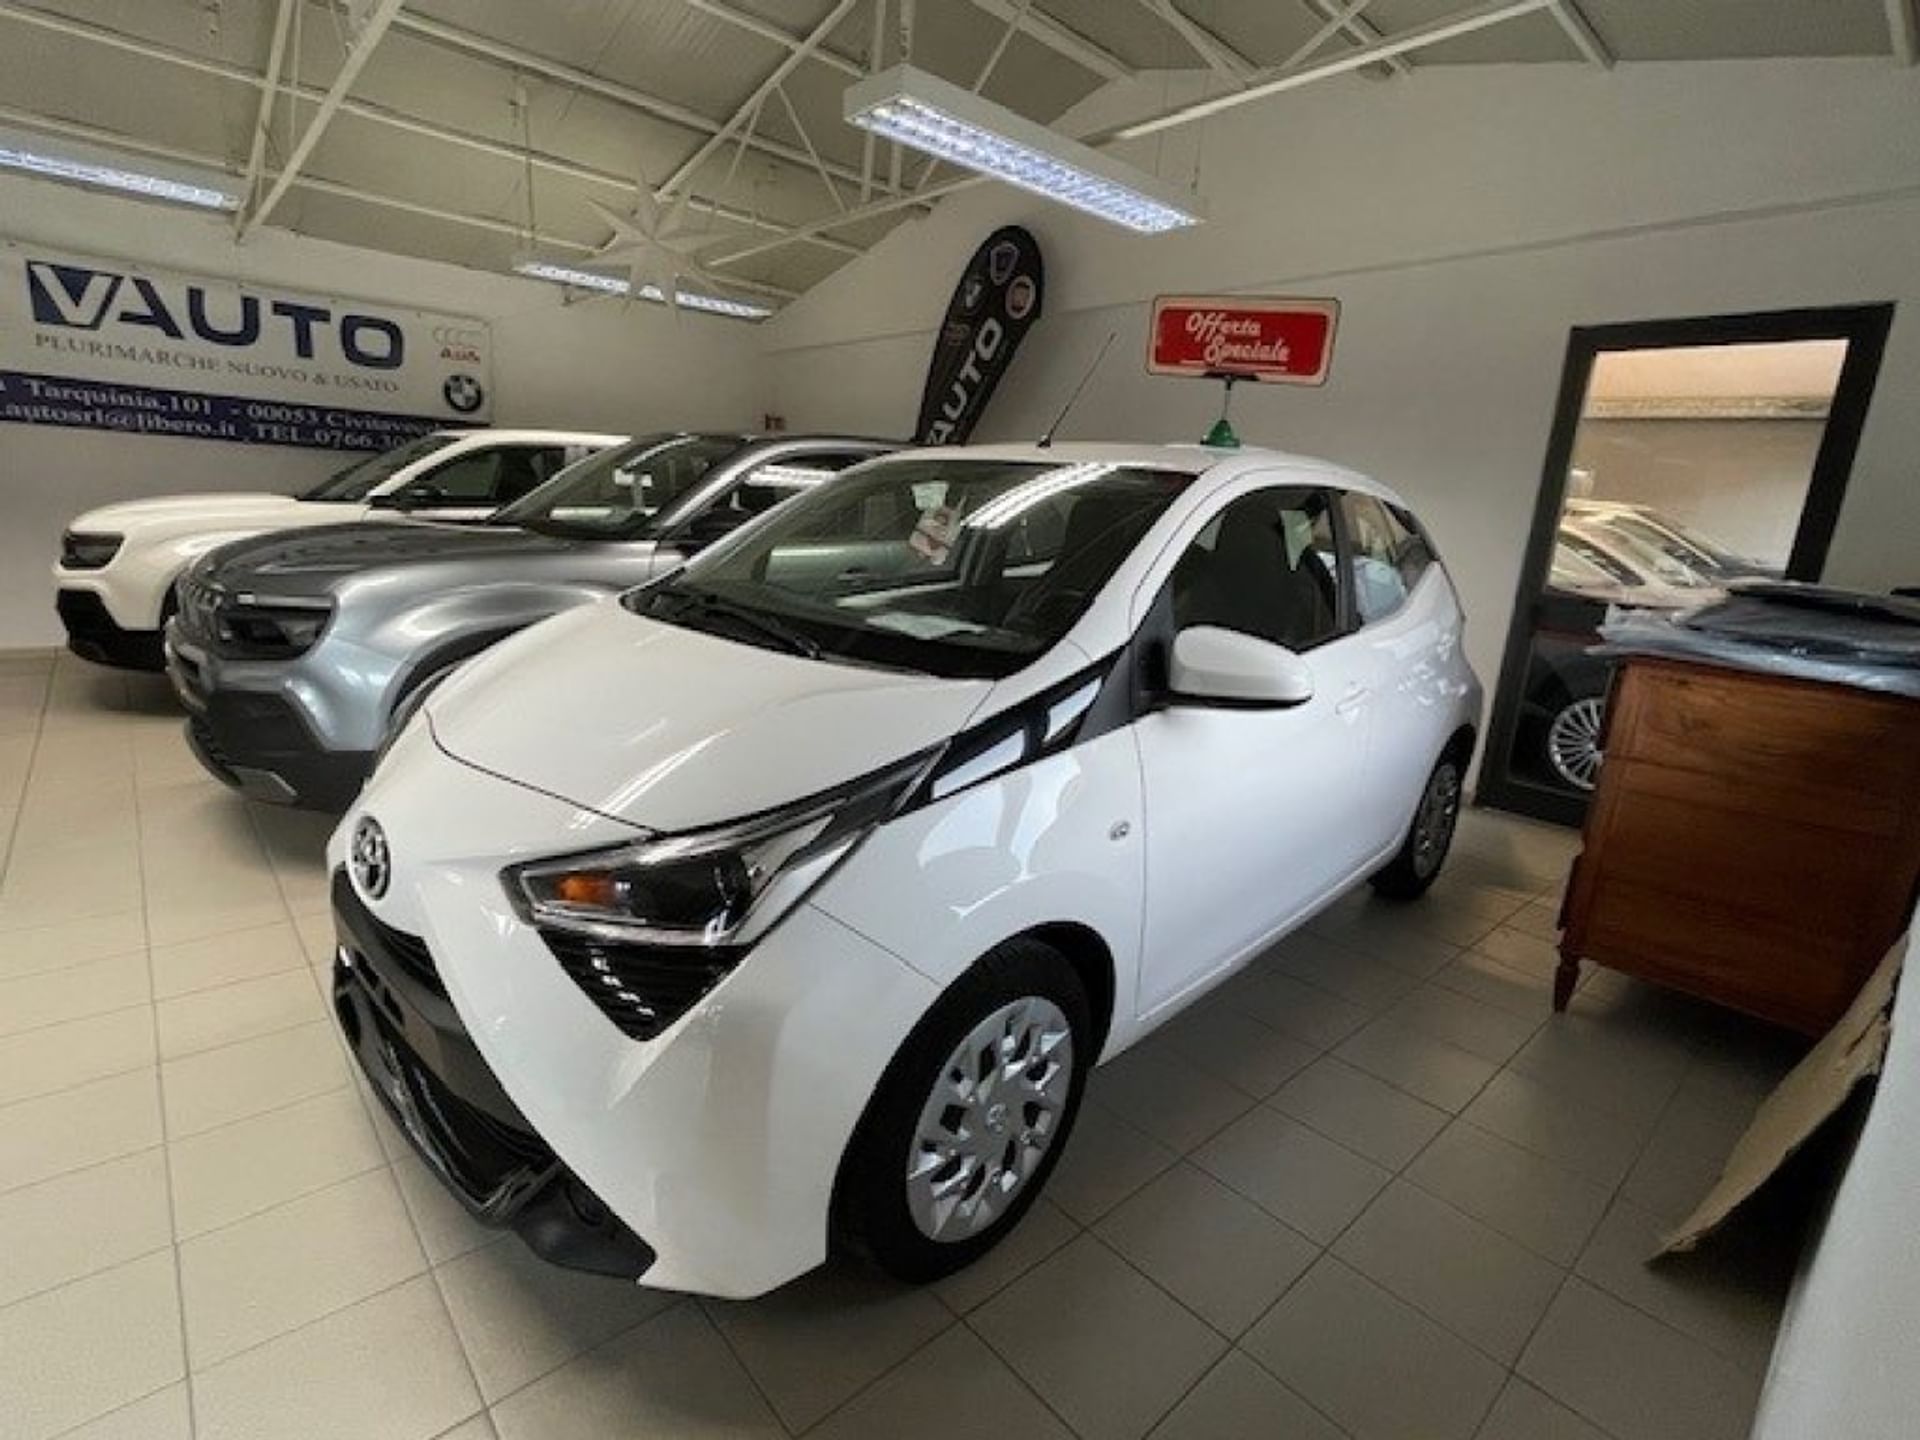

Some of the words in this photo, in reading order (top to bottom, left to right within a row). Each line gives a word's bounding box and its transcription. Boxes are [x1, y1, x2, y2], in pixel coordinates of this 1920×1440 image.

[26, 260, 405, 370] VAUTO
[1185, 312, 1262, 342] Offerta
[35, 333, 219, 371] PLURIMARCHE
[228, 360, 307, 383] NUOVO
[312, 373, 326, 386] &
[334, 374, 399, 393] USATO
[1203, 335, 1291, 368] Speciale
[247, 402, 319, 426] 00053
